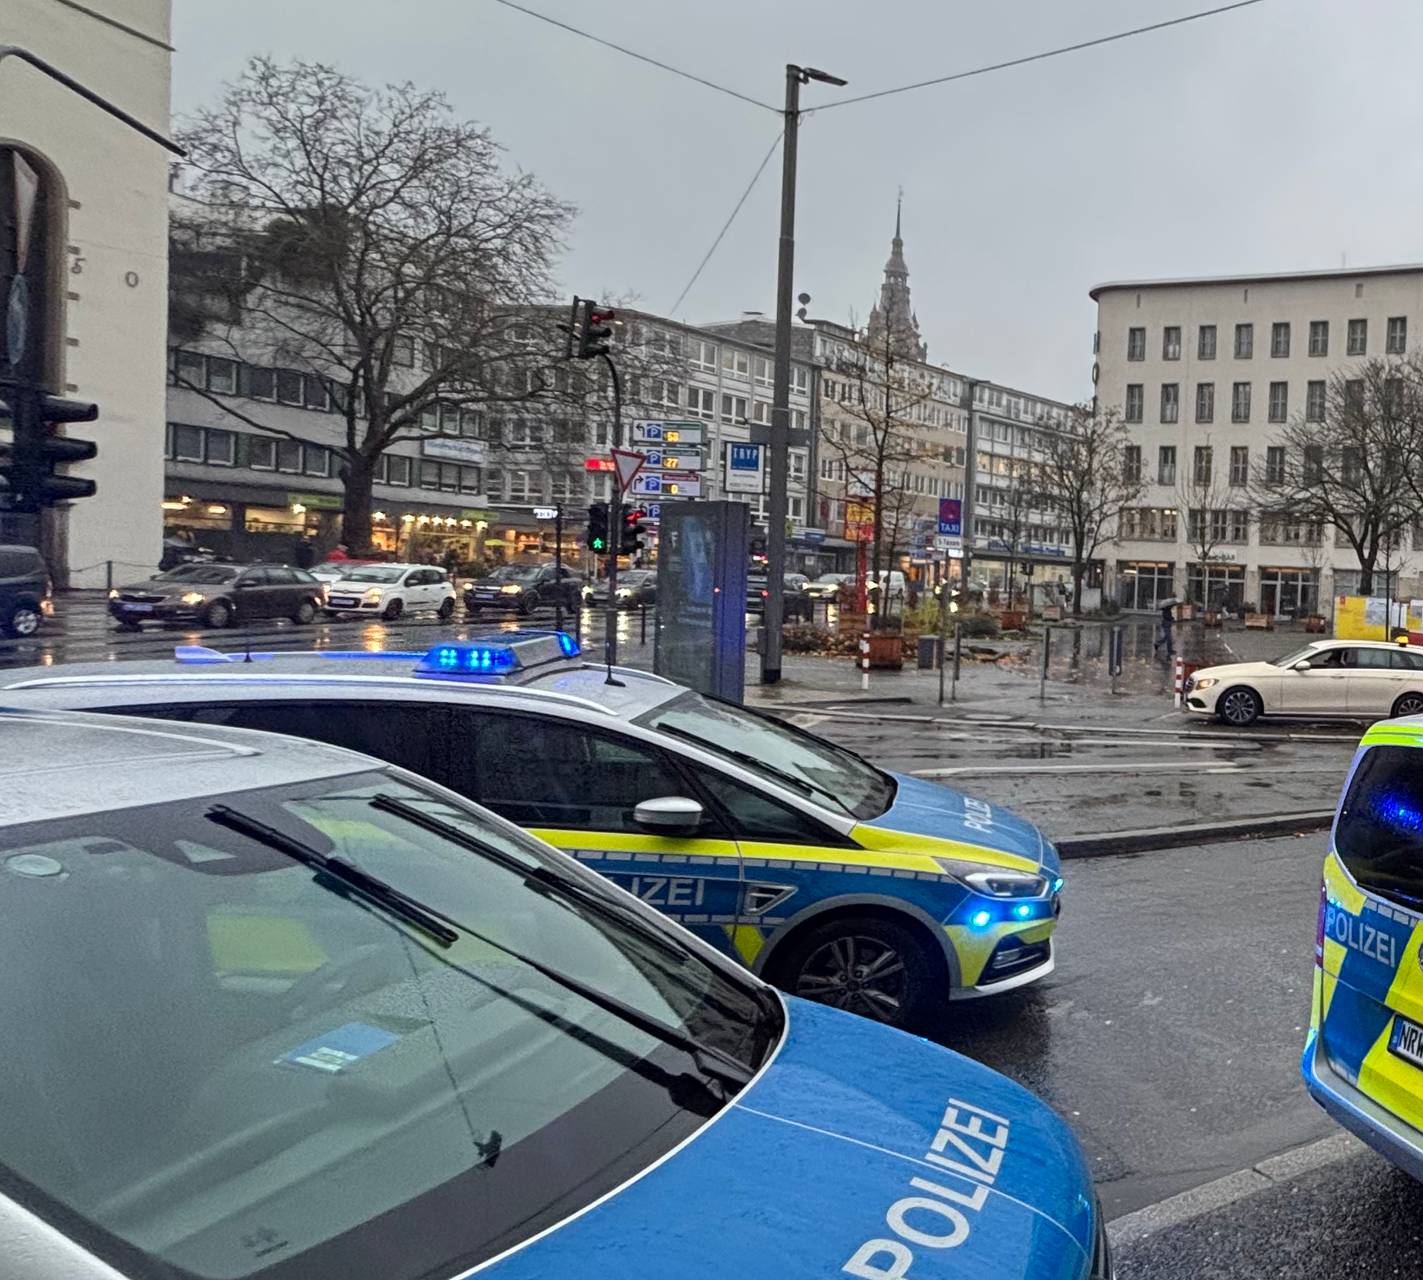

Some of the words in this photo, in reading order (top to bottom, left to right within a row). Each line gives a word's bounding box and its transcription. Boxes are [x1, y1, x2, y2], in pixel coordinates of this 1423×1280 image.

[733, 447, 757, 461] TRYP
[940, 522, 960, 533] TAXI
[963, 796, 992, 834] POLIZEI
[1326, 906, 1396, 969] POLIZEI
[841, 1097, 1010, 1280] POLIZEI
